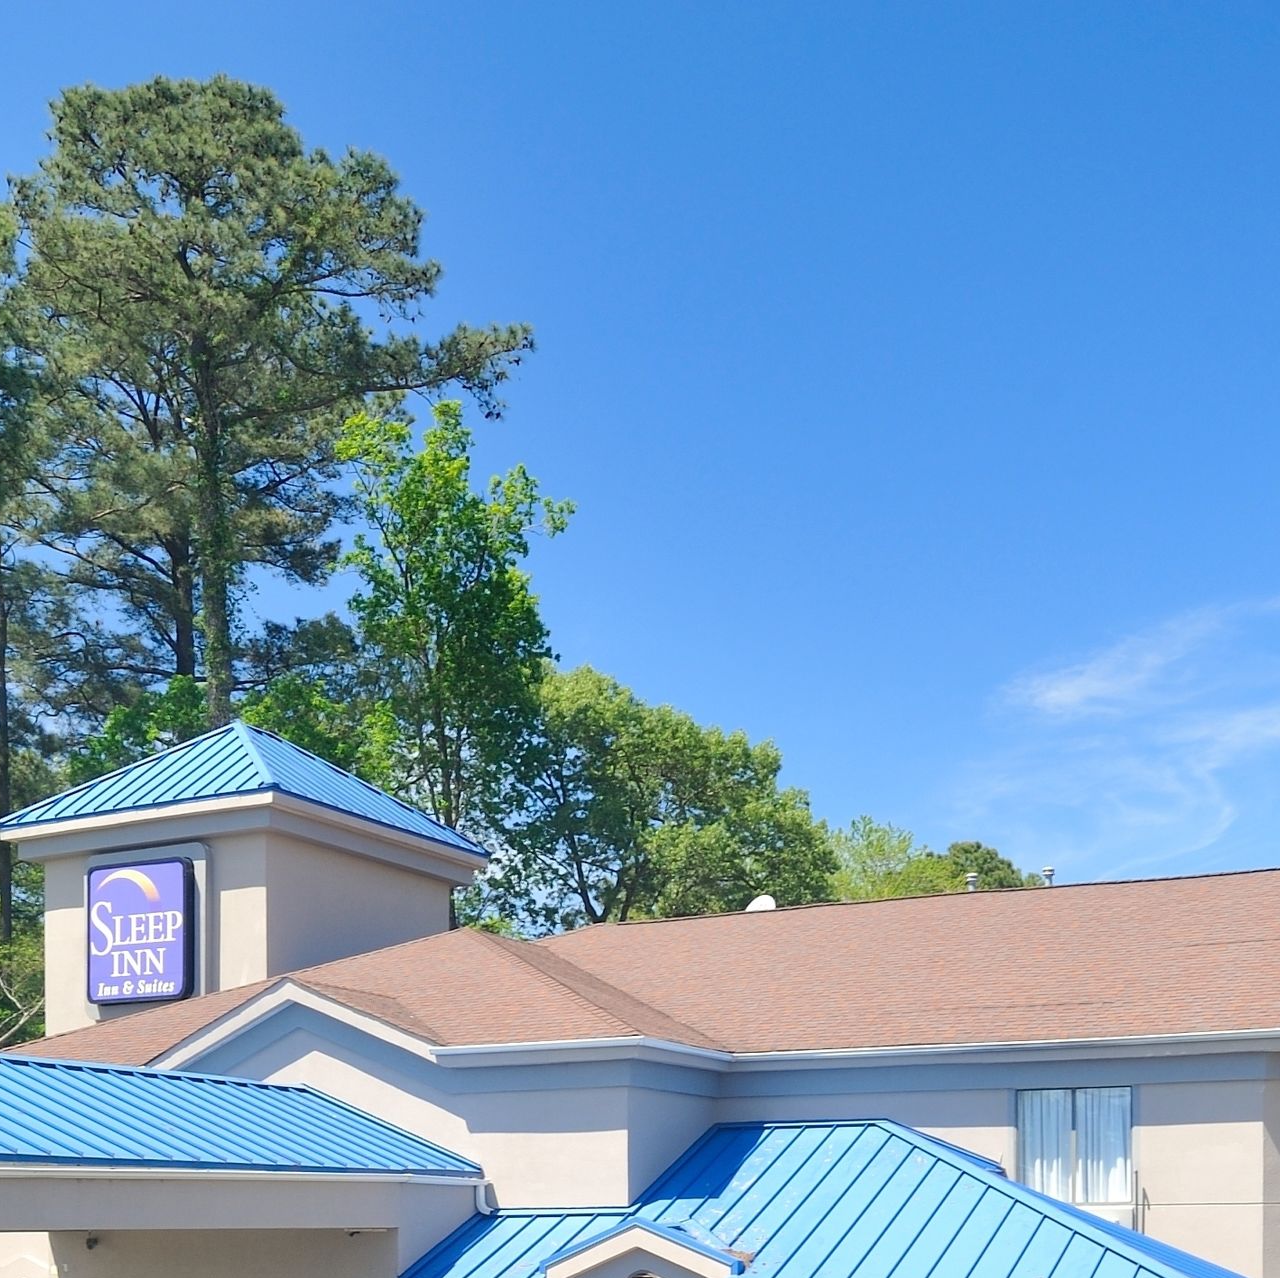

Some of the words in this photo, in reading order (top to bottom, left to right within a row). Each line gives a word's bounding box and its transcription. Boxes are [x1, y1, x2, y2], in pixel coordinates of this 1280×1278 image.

[90, 901, 183, 956] SLEEP
[110, 947, 167, 978] INN
[97, 983, 120, 997] Inn
[122, 980, 134, 995] &
[136, 978, 175, 994] Suites
